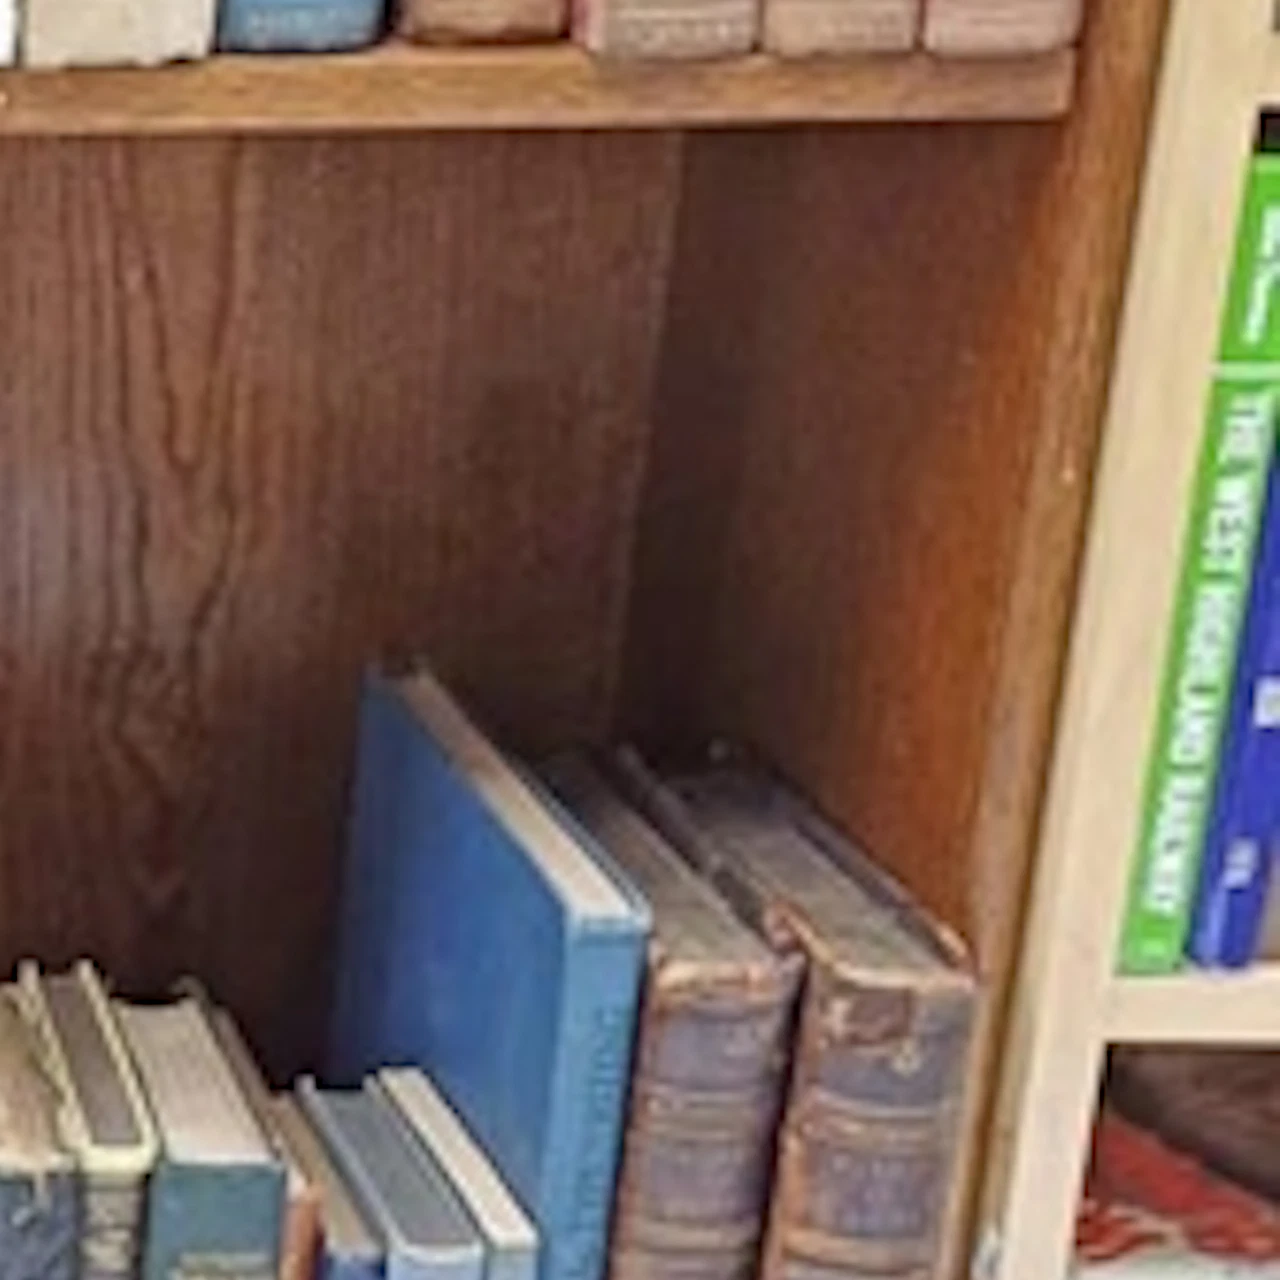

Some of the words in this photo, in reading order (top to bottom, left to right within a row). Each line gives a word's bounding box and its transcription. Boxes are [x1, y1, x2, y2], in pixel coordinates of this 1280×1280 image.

[1214, 390, 1275, 464] THE
[1198, 474, 1256, 572] WEST
[1170, 580, 1242, 764] HIGHLAND
[1142, 774, 1210, 915] RAILWAY
